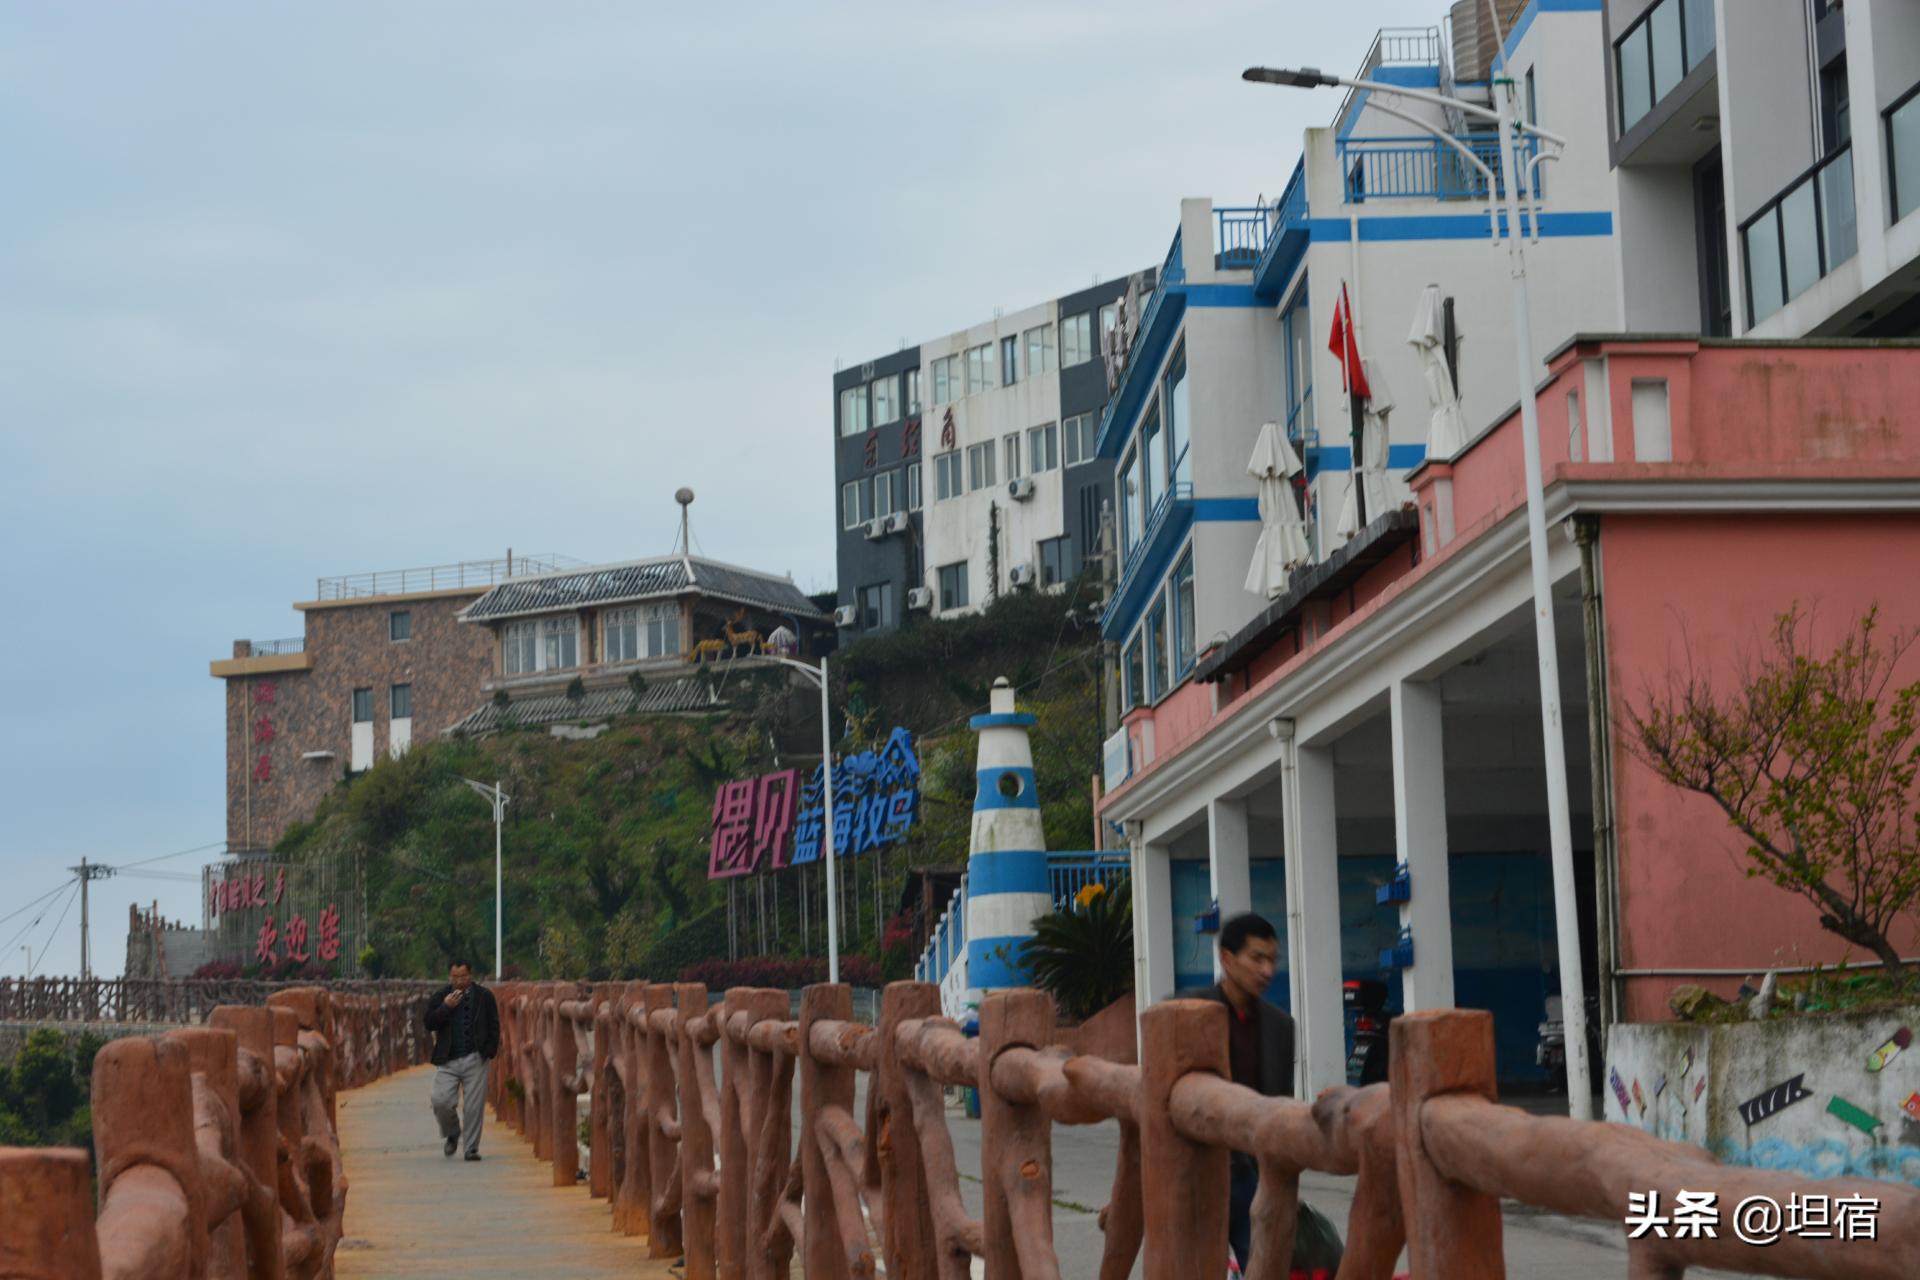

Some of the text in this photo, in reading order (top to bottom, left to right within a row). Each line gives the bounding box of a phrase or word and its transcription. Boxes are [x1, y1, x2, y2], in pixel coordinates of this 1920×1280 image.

[708, 768, 797, 880] 遇见
[256, 903, 342, 965] 欢迎您
